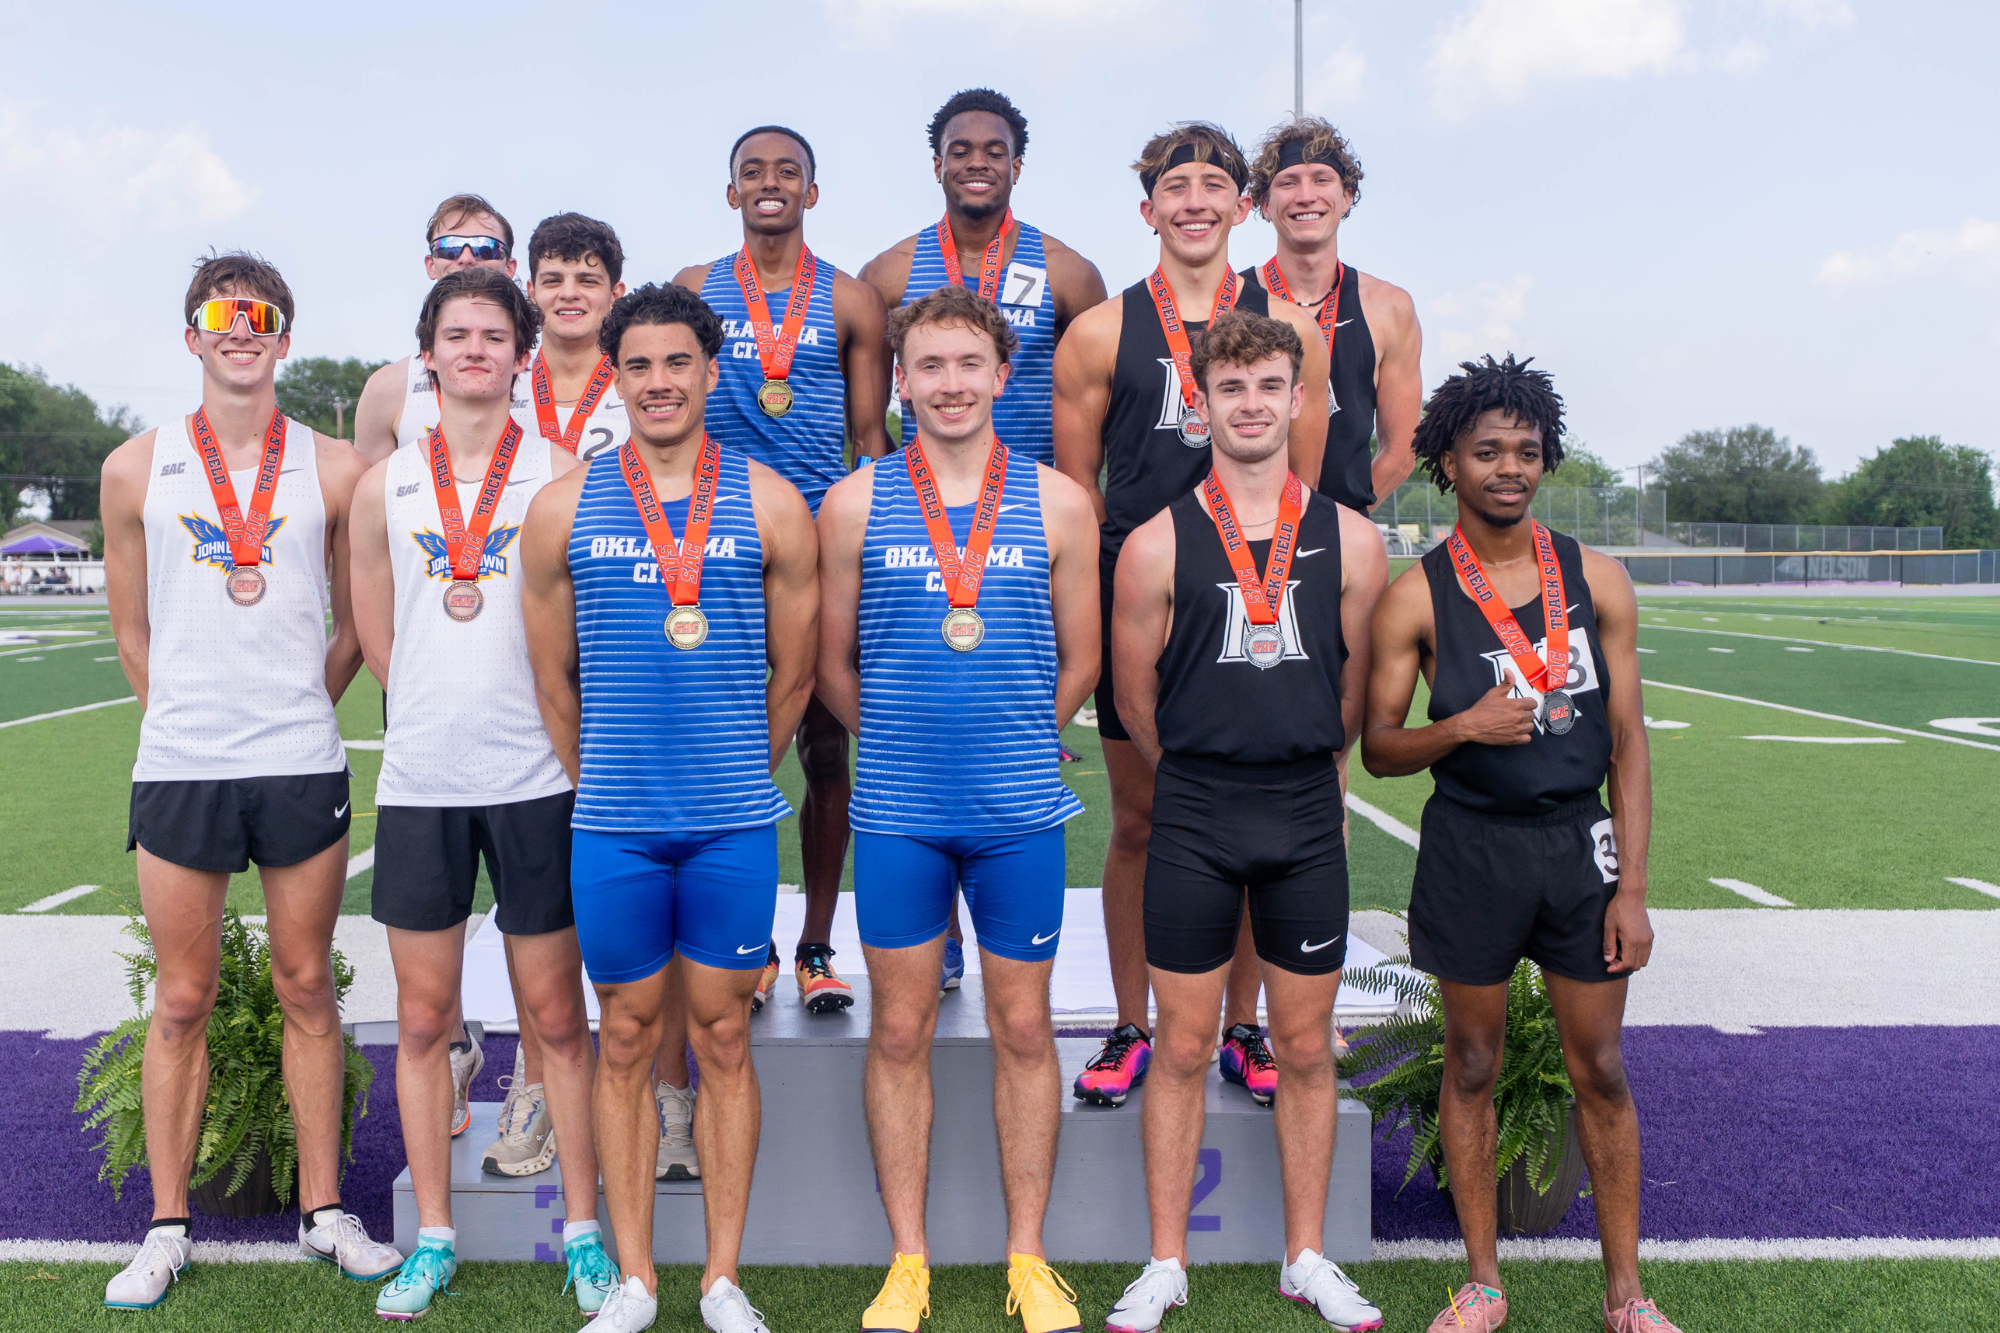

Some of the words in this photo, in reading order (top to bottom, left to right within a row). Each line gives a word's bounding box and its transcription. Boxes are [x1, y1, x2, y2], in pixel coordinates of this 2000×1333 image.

[742, 271, 761, 304] FIELD
[1013, 273, 1036, 304] 7
[1266, 262, 1284, 293] FIELD
[789, 279, 810, 318] TRACK
[1160, 297, 1180, 333] FIELD
[754, 321, 776, 353] SAC
[775, 332, 797, 369] SAC
[413, 382, 433, 393] SA
[510, 400, 529, 409] AC
[535, 375, 551, 406] FIELD
[577, 378, 605, 416] TRACK
[764, 393, 787, 404] SAC
[541, 421, 560, 441] SA
[562, 428, 580, 455] AC
[583, 427, 614, 461] 2
[1185, 422, 1208, 434] SAC
[160, 462, 187, 476] SAC
[204, 445, 227, 485] FIELD
[258, 445, 281, 493] TRACK
[434, 452, 451, 489] FIELD
[477, 470, 503, 516] TRACK
[502, 423, 520, 460] FIELD
[396, 482, 421, 497] SAC
[635, 480, 661, 523] FIELD
[692, 474, 713, 525] TRACK
[918, 477, 942, 520] FIELD
[975, 481, 999, 532] TRACK
[220, 506, 244, 542] SAC
[243, 508, 267, 549] SAC
[442, 508, 467, 543] SAC
[1215, 502, 1242, 552] TRACK
[196, 541, 225, 559] JOHN
[459, 532, 484, 574] SAC
[590, 537, 736, 558] OKLAMA
[934, 542, 962, 579] SAC
[1273, 522, 1294, 565] FIELD
[1535, 525, 1555, 563] FIELD
[431, 555, 449, 575] JOH
[655, 544, 680, 582] SAC
[680, 542, 703, 585] SAC
[960, 549, 985, 592] SAC
[1807, 557, 1868, 578] NELSON
[233, 580, 259, 592] SAC
[1236, 568, 1265, 604] SAC
[1463, 562, 1494, 603] FIELD
[449, 595, 477, 608] SAC
[1545, 577, 1563, 630] TRACK
[672, 621, 700, 634] SAC
[951, 623, 977, 637] SAC
[1494, 619, 1531, 657] SAC
[1251, 640, 1278, 654] SAC
[1549, 650, 1567, 689] SAC
[1550, 705, 1568, 721] SAC
[1599, 833, 1619, 876] 3
[1187, 1149, 1221, 1231] 2
